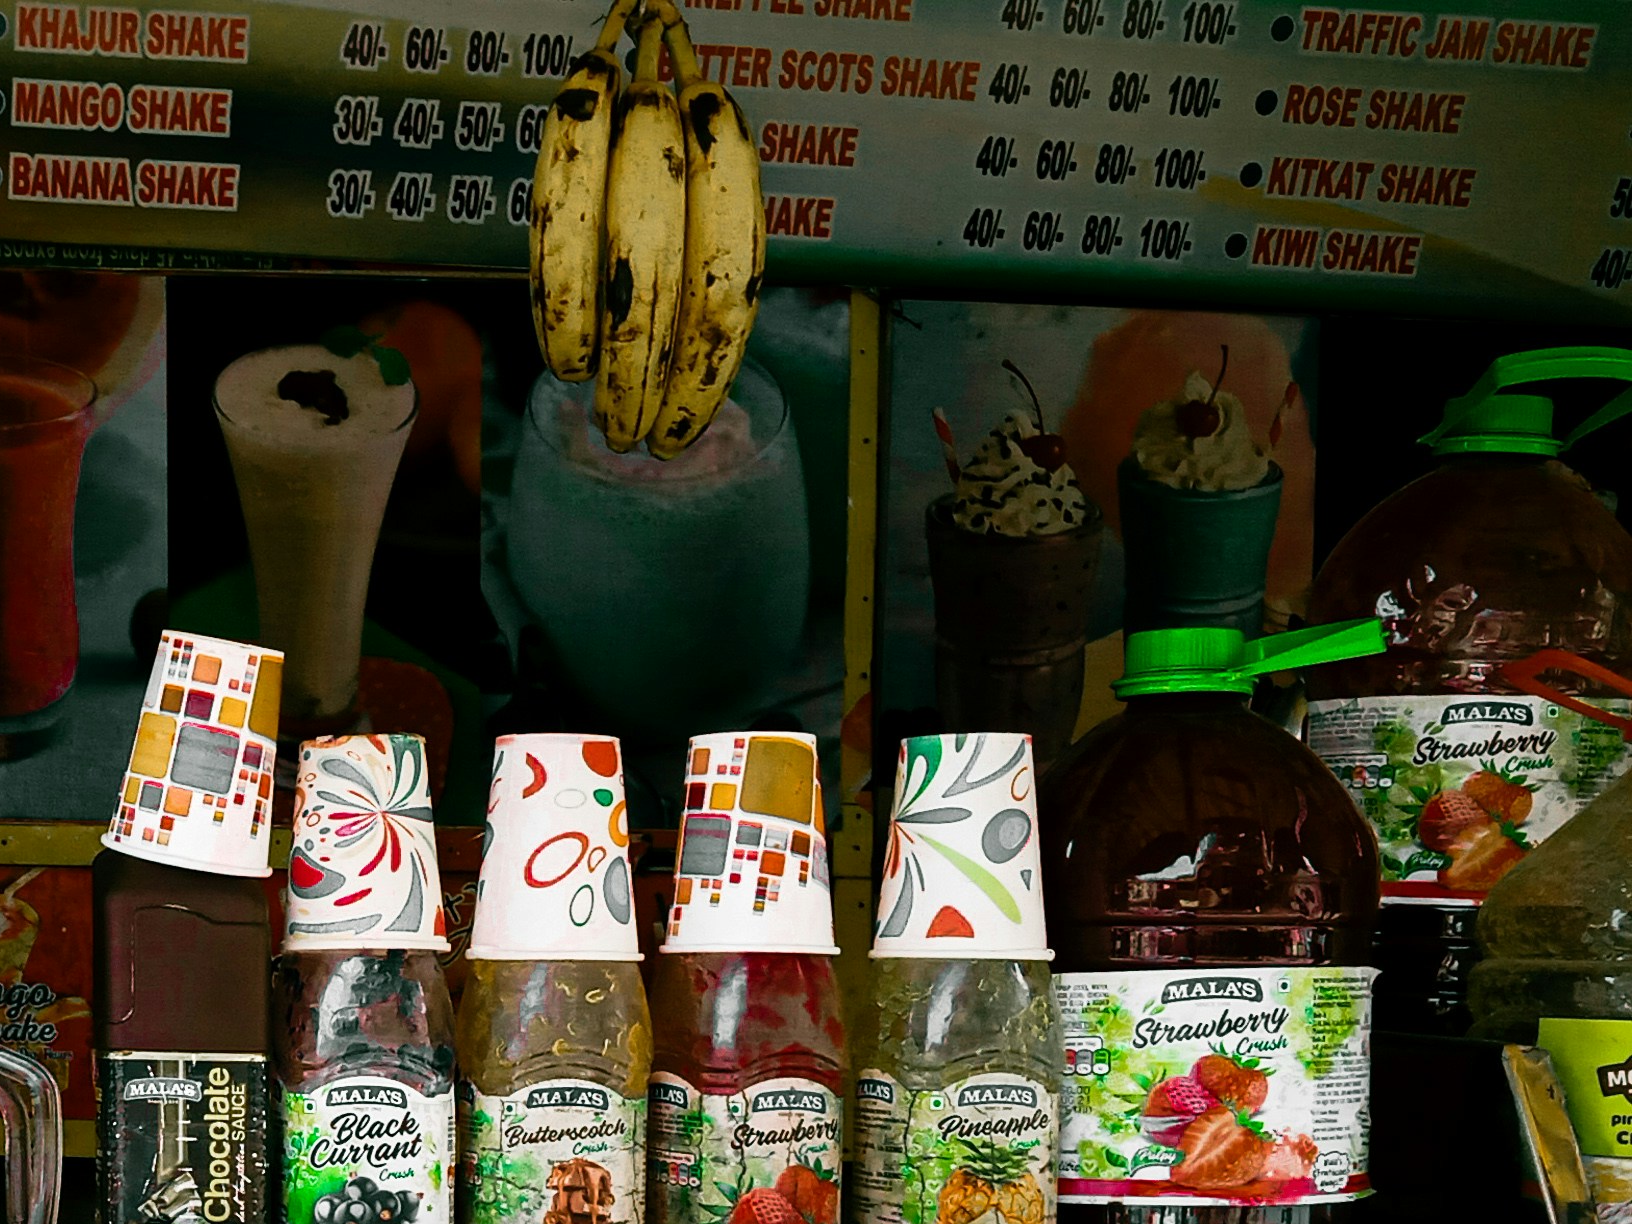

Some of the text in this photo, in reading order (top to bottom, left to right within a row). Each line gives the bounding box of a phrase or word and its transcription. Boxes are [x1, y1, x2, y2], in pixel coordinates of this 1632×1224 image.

[18, 7, 138, 53] KHAJUR
[147, 14, 246, 59] SHAKE
[343, 24, 386, 66] 40/-
[406, 27, 447, 70] 60/-
[468, 31, 509, 73] 80/-
[1123, 0, 1164, 39] 80/-
[1184, 2, 1235, 44] 100/-
[1302, 11, 1595, 67] TRAFFIC JAM SHAKE
[658, 43, 1220, 118] BTTER SCOTS SHAKE 40/- 60/- 80/- 100/-
[15, 83, 121, 128] MANGO
[130, 88, 228, 133] SHAKE
[338, 100, 379, 141] 30/-
[397, 102, 440, 143] 40/-
[459, 105, 501, 147] 50/-
[1283, 85, 1466, 133] ROSE SHAKE
[760, 123, 1206, 189] SHAKE 40/- 60/- 80/- 100/-
[13, 156, 130, 202] BANANA
[138, 163, 236, 207] SHAKE
[330, 173, 372, 214] 30/-
[391, 176, 432, 217] 40/-
[451, 180, 492, 220] 50/-
[1267, 157, 1374, 201] KITKAT
[1377, 164, 1476, 207] SHAKE
[963, 208, 1005, 248] 40/-
[1023, 211, 1064, 251] 60/-
[1082, 215, 1122, 255] 80/-
[1140, 219, 1191, 260] 100/-
[1252, 228, 1319, 268] KIWI
[1323, 232, 1421, 275] SHAKE
[1448, 706, 1527, 722] MALA'S
[1413, 730, 1557, 766] Strawberry
[1504, 755, 1554, 773] Crush
[1169, 980, 1257, 1000] MALA'S
[1132, 1007, 1289, 1049] Strawberry
[1236, 1038, 1289, 1055] Crush
[129, 1082, 196, 1097] MALA'S
[330, 1089, 403, 1104] MALA'S
[532, 1090, 604, 1105] MALA'S
[757, 1095, 823, 1110] MALA'S
[963, 1089, 1033, 1104] MALA'S
[231, 1084, 245, 1141] SAUCE
[331, 1112, 420, 1145] Black
[938, 1109, 1050, 1141] Pineapple
[204, 1068, 230, 1222] Chocolate
[310, 1133, 423, 1168] Currant
[505, 1118, 627, 1148] Butterscotch
[731, 1118, 839, 1150] Strawberry
